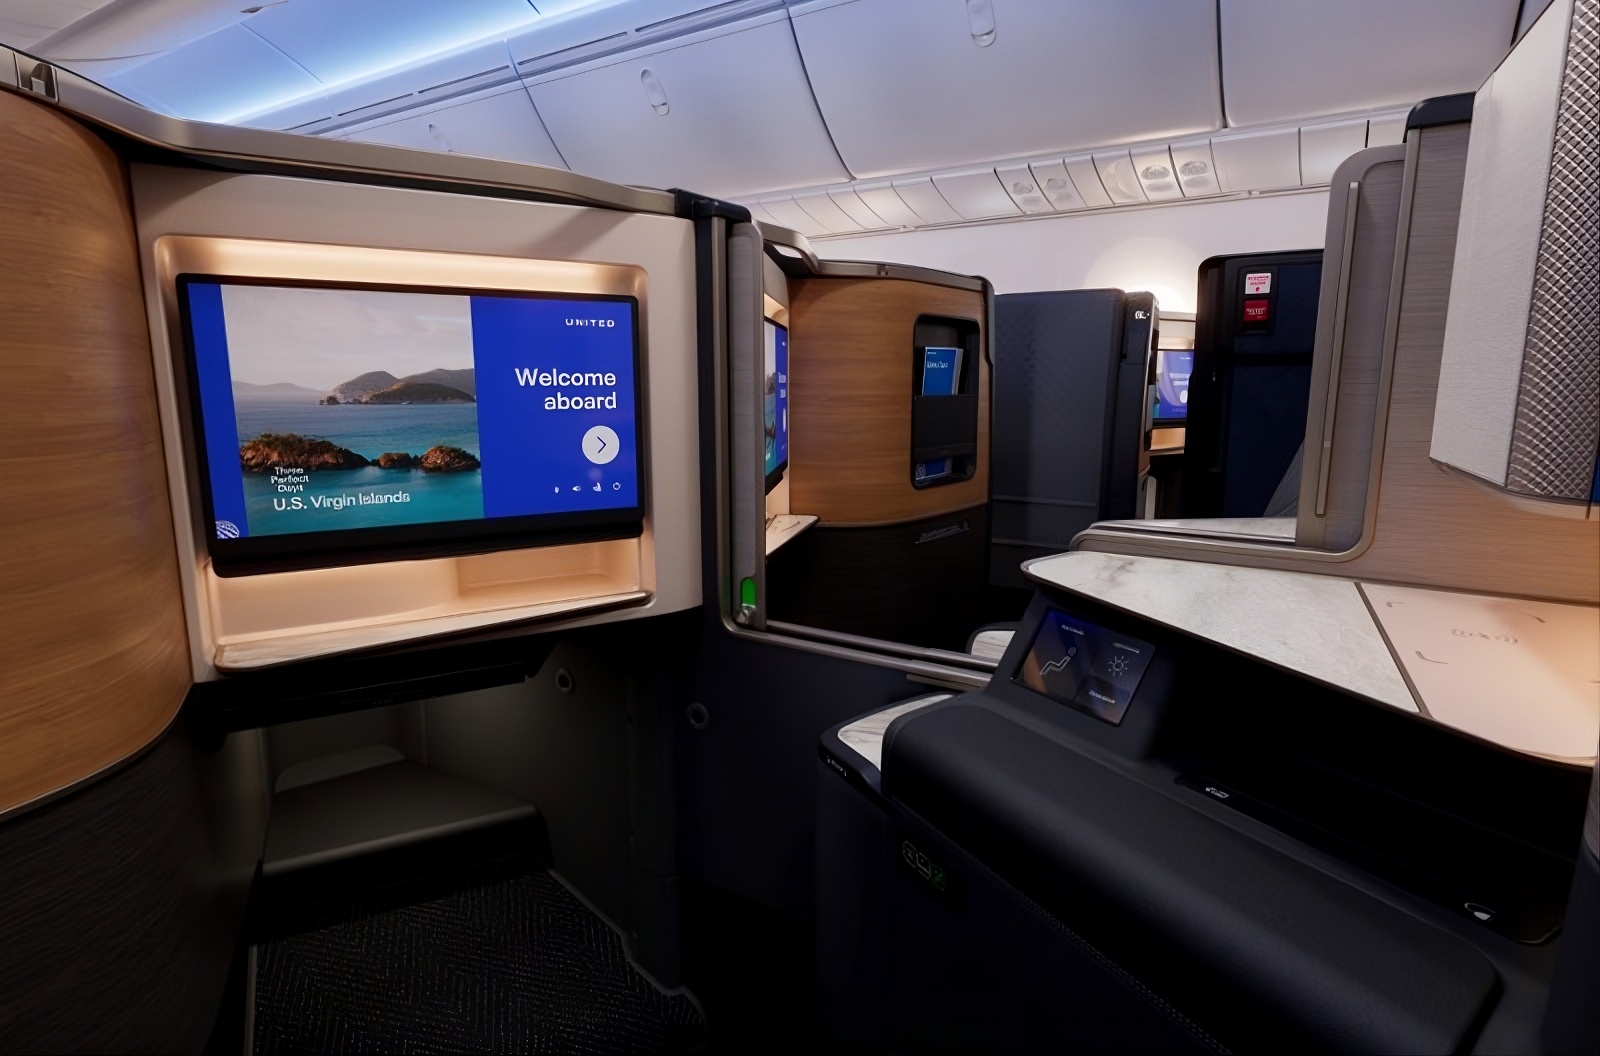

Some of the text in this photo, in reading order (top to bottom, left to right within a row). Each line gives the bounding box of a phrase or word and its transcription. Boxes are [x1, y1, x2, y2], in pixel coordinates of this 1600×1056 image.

[565, 318, 615, 328] UNITED
[514, 368, 617, 387] Welcome
[544, 391, 617, 410] aboard
[273, 496, 308, 511] U.S.
[310, 493, 356, 511] Virgin
